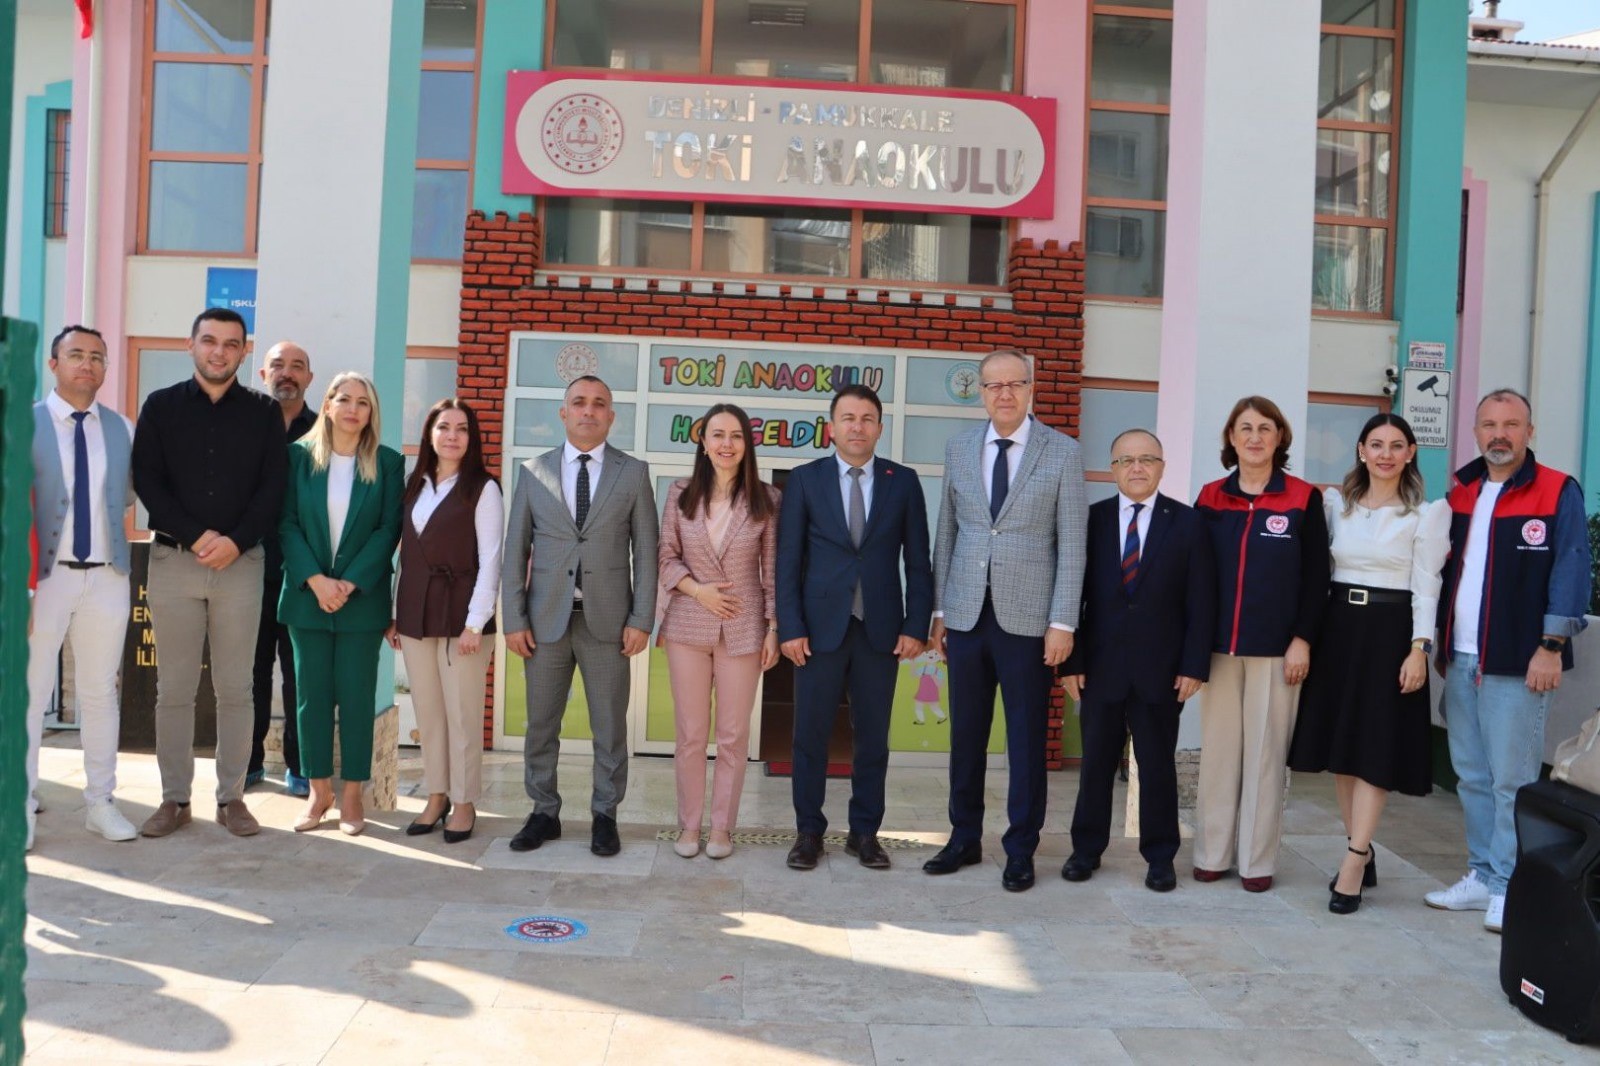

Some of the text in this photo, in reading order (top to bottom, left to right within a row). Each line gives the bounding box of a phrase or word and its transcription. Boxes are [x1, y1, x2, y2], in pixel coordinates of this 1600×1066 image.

[649, 89, 755, 122] DENİZLİ
[778, 101, 954, 133] PAMUKKALE
[645, 130, 752, 182] TOKİ
[776, 135, 1025, 196] ANAOKULU
[659, 354, 726, 387] TOKİ
[670, 414, 703, 444] HO
[1411, 425, 1432, 433] AMERA
